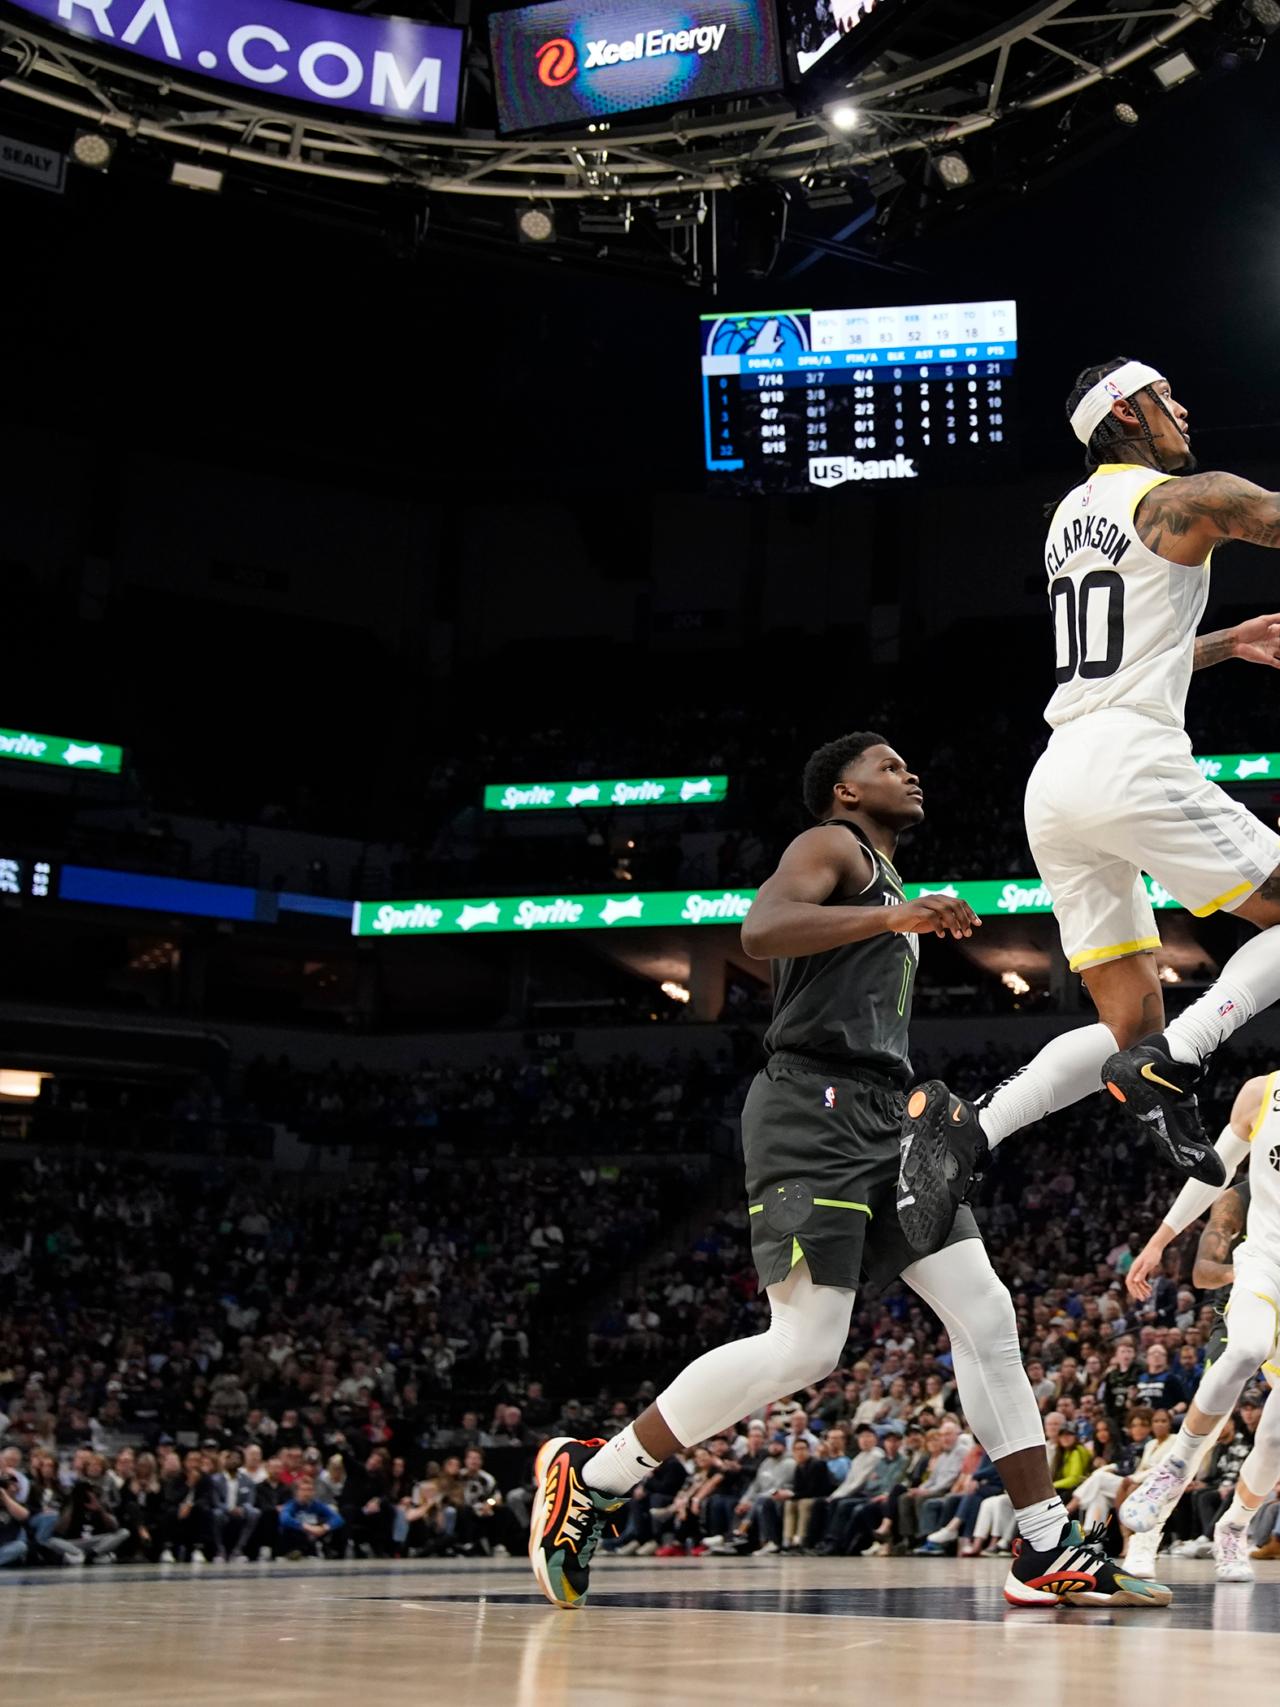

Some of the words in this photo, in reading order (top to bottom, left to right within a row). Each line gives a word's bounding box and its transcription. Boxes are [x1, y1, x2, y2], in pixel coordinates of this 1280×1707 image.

[584, 33, 645, 68] Xcel
[645, 24, 727, 57] Energy
[907, 331, 922, 342] 52
[987, 363, 1000, 374] 21
[920, 382, 929, 395] 2
[987, 379, 1002, 391] 24
[968, 397, 978, 410] 3
[921, 416, 930, 429] 4
[969, 414, 979, 427] 3
[969, 430, 979, 443] 4
[1047, 515, 1132, 577] CLARKSON
[1051, 570, 1125, 685] 00
[501, 785, 556, 810] Sprite
[611, 781, 666, 806] Sprite
[372, 903, 443, 934] Sprite
[513, 899, 584, 929] Sprite
